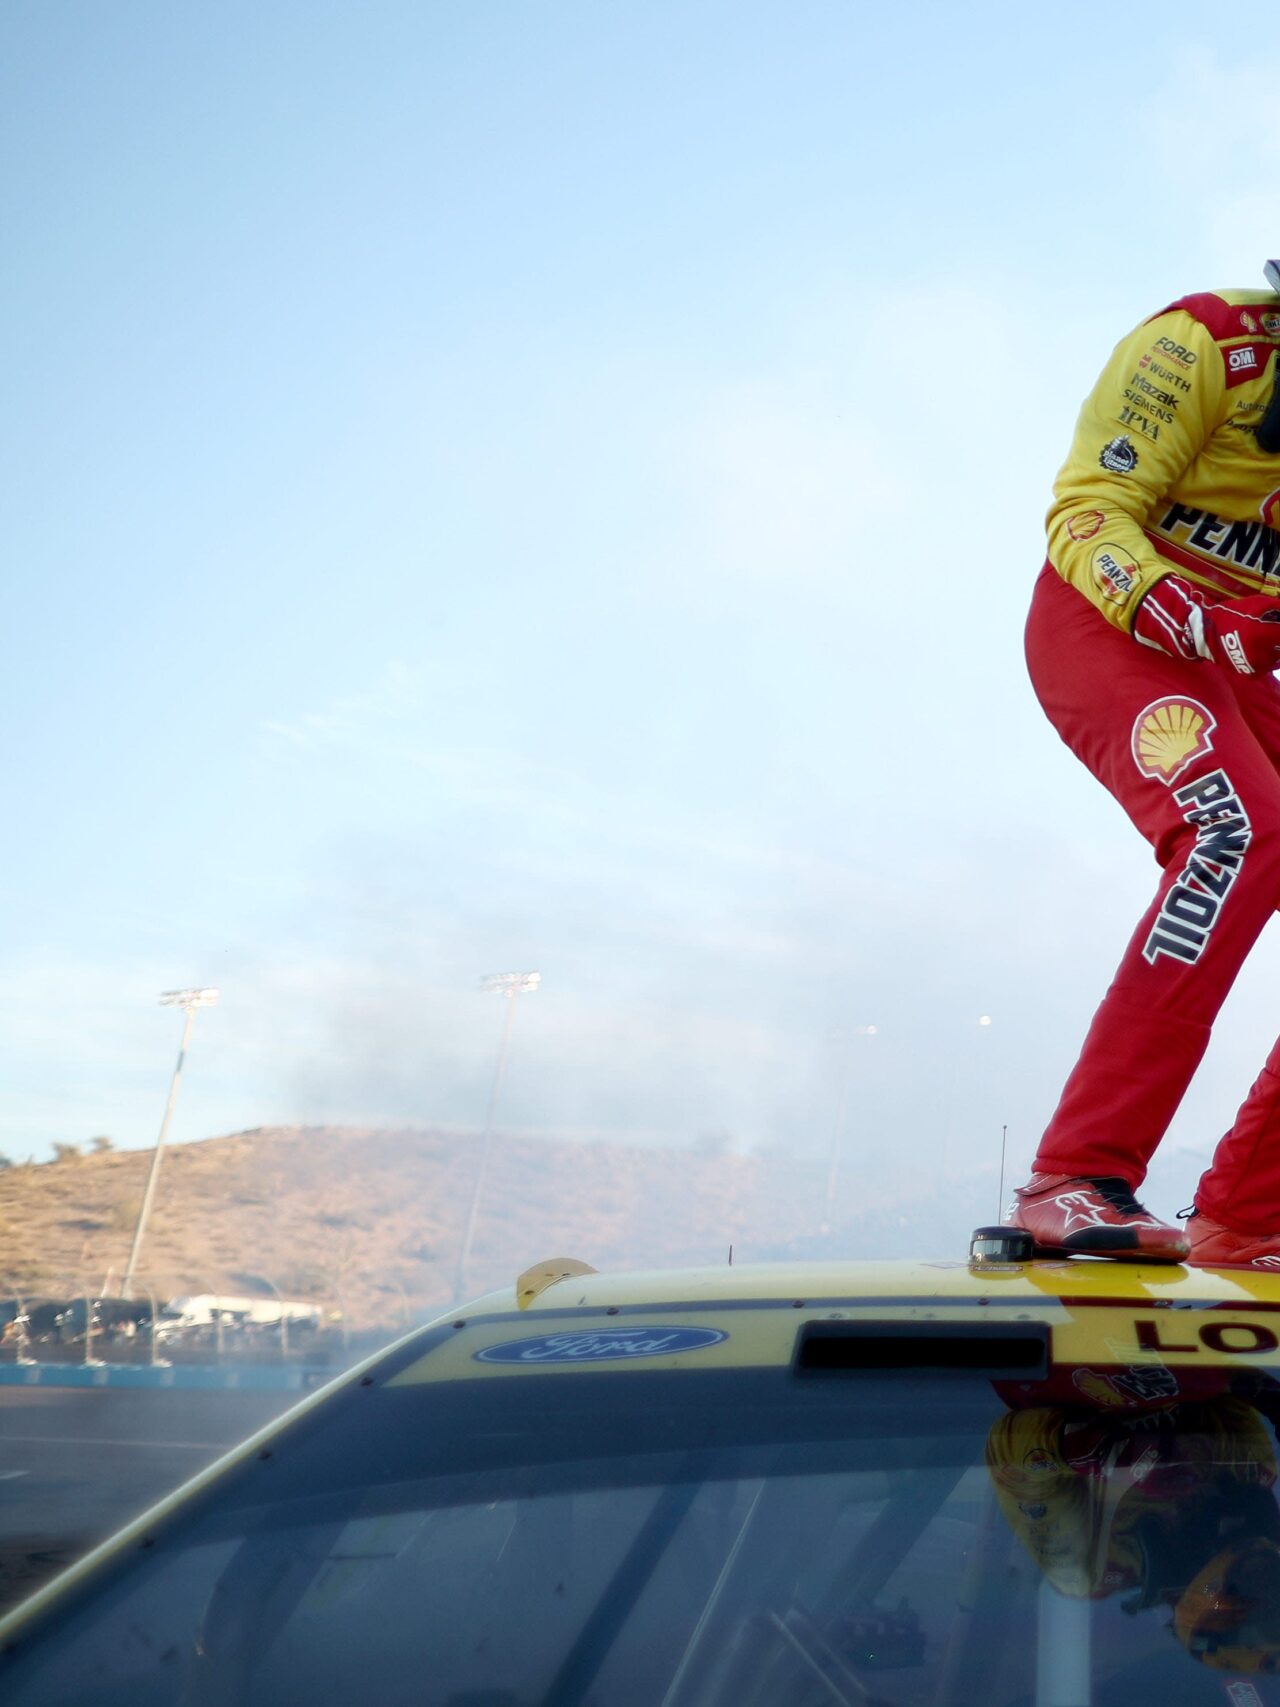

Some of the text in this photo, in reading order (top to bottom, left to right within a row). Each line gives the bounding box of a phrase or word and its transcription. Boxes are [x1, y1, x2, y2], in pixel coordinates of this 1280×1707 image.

[1154, 336, 1197, 365] FORD
[1130, 372, 1181, 411] Mazak
[1149, 361, 1192, 393] WÜRTH
[1122, 388, 1174, 425] SIEMENS
[1102, 450, 1130, 466] planet
[1222, 629, 1252, 675] OMP
[1142, 768, 1252, 965] PENNZOIL
[521, 1330, 679, 1359] Ford
